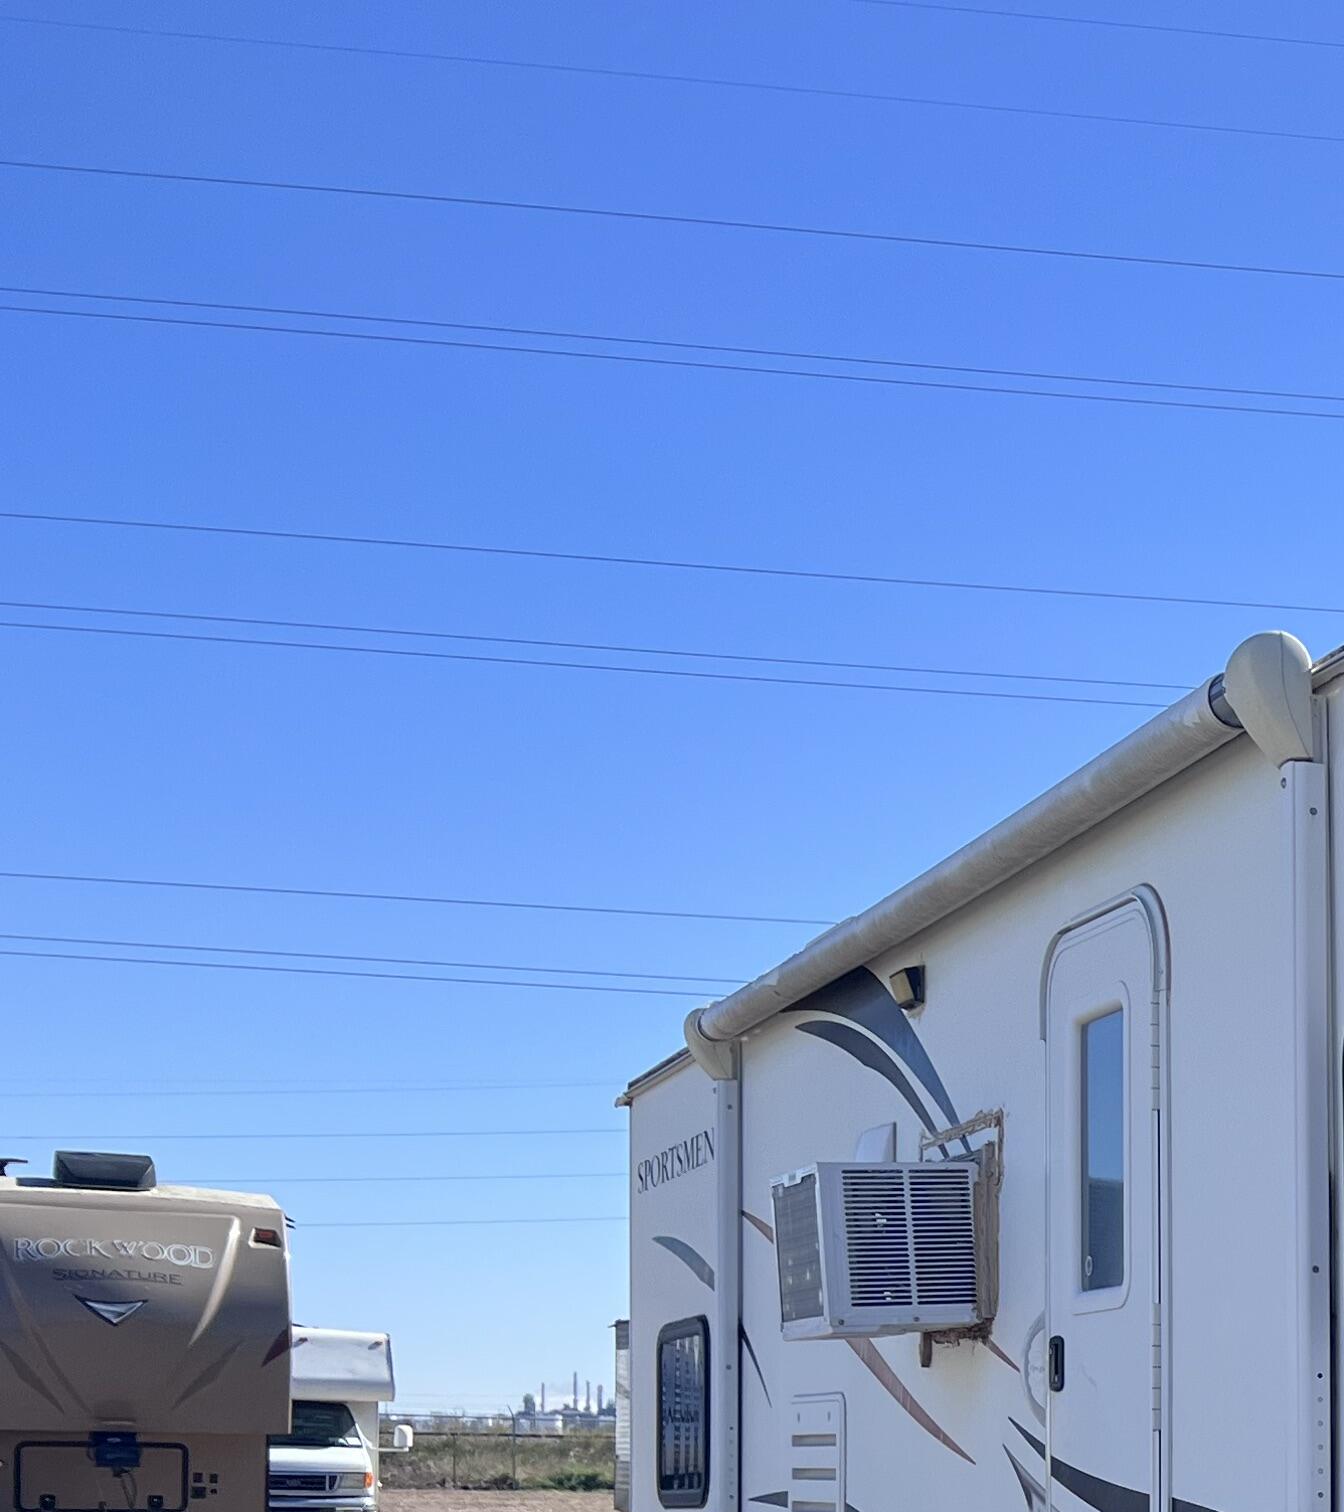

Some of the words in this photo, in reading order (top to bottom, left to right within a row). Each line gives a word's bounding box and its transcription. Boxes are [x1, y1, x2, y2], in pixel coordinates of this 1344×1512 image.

[637, 1126, 715, 1194] SPORTSMEN
[14, 1237, 214, 1269] ROCKWOOD
[53, 1267, 183, 1286] SIGNATURE
